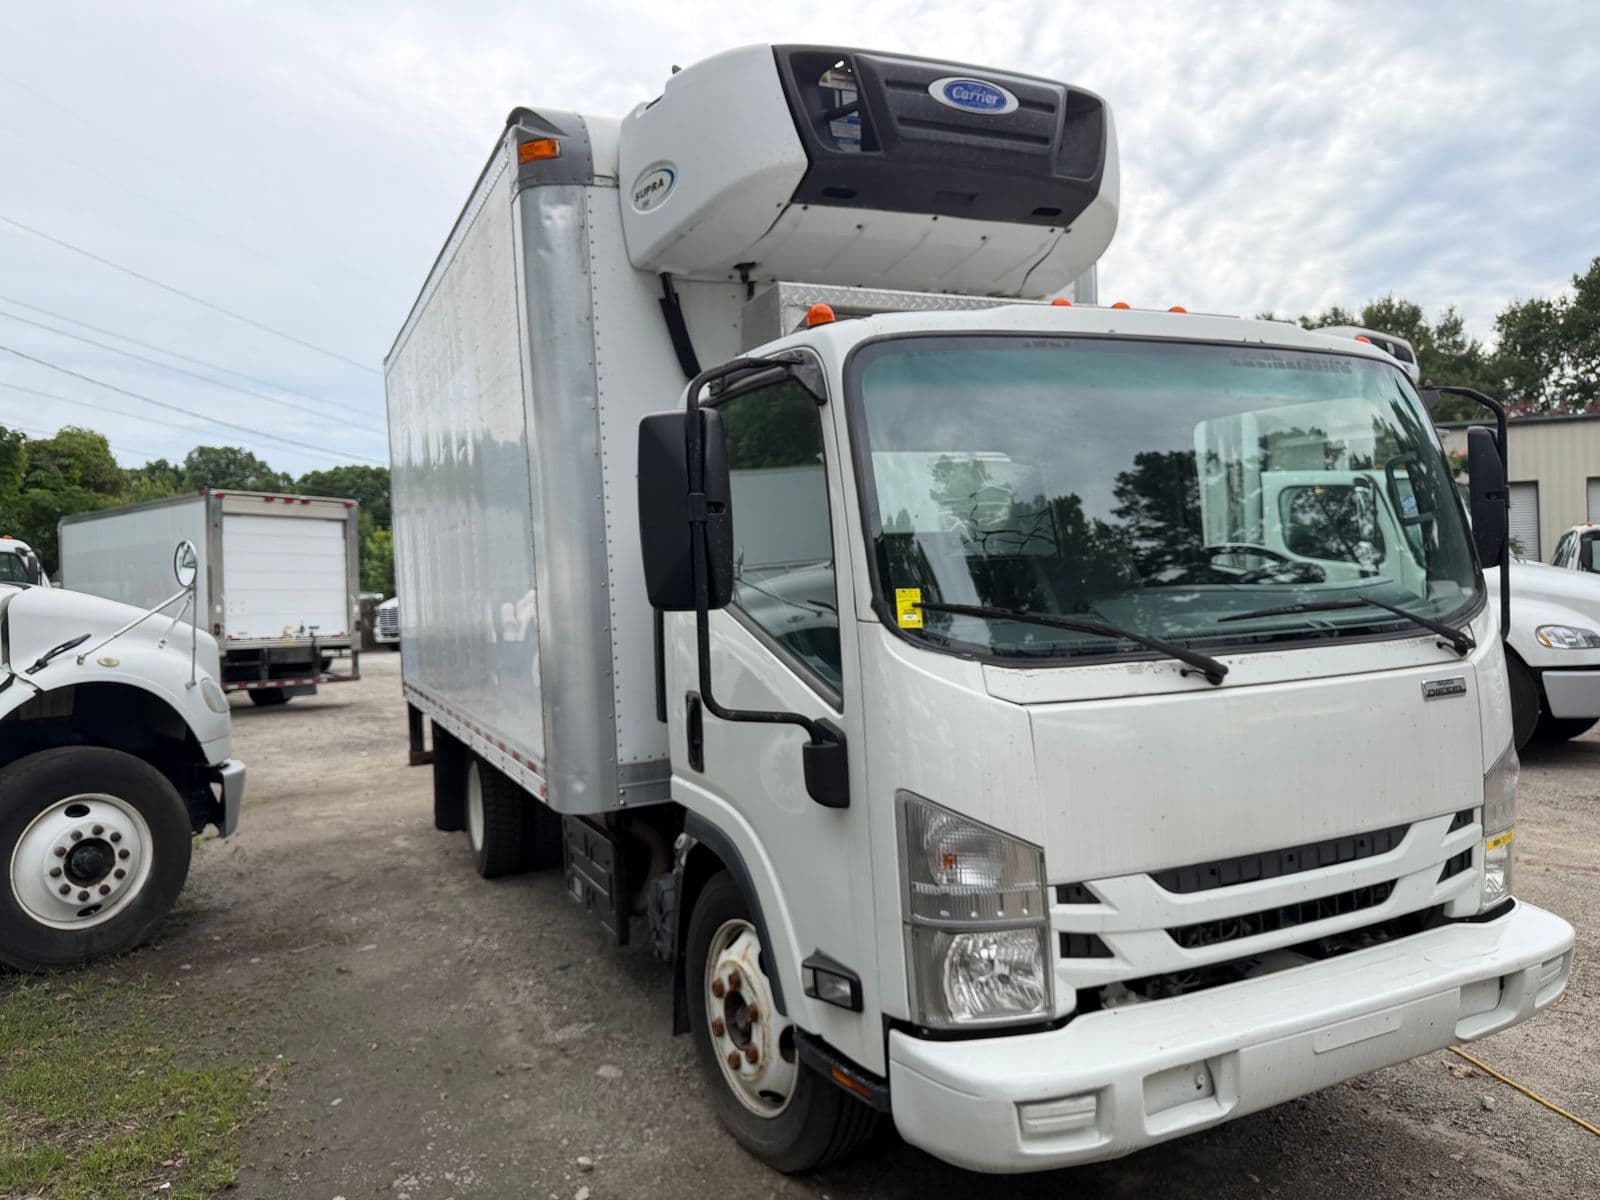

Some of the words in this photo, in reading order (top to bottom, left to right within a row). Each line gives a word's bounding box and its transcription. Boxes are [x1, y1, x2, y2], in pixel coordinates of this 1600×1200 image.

[951, 85, 1000, 105] Carrier
[634, 177, 665, 202] SUPRA
[1426, 685, 1467, 698] DIESEL
